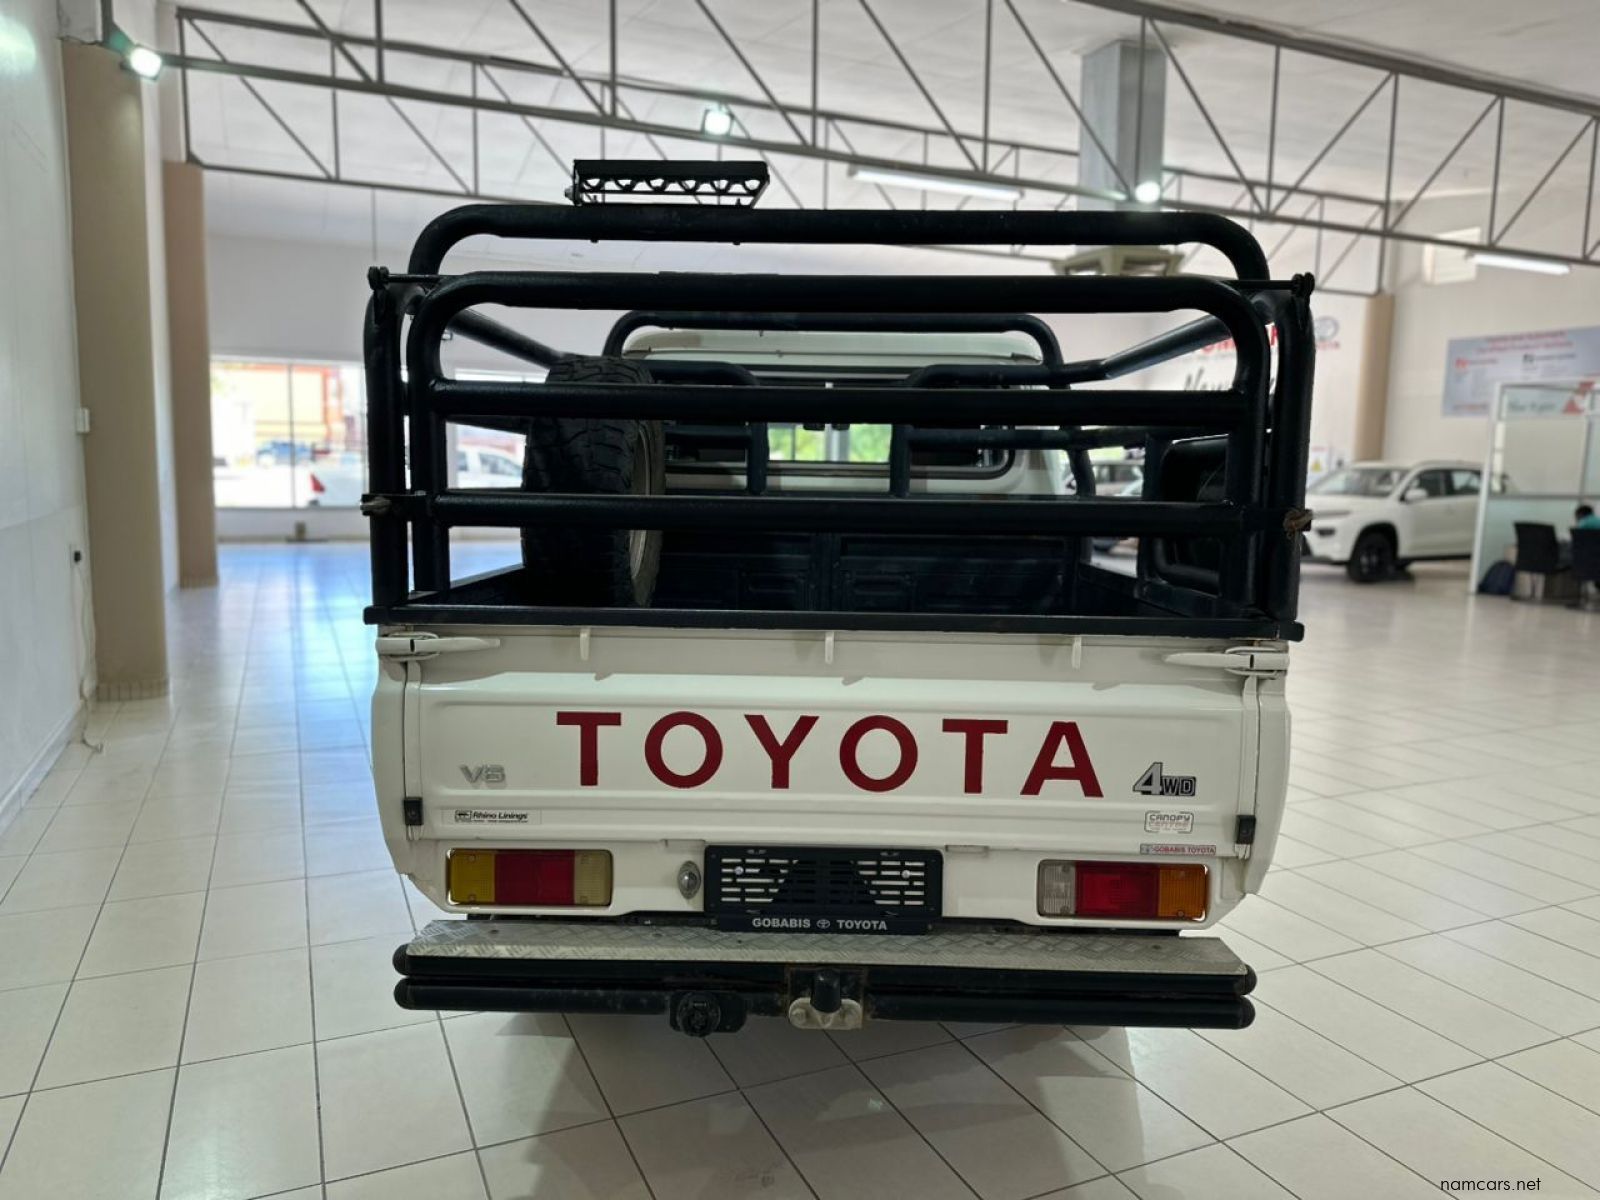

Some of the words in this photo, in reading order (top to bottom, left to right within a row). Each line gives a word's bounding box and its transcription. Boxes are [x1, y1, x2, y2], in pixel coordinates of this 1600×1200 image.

[556, 711, 1104, 798] TOYOTA
[1132, 761, 1196, 796] 4WD
[473, 811, 497, 819] Rhino
[498, 811, 528, 821] Linings
[1188, 847, 1216, 855] TOYOTA
[752, 917, 811, 929] GOBABIS
[836, 918, 888, 931] TOYOTA
